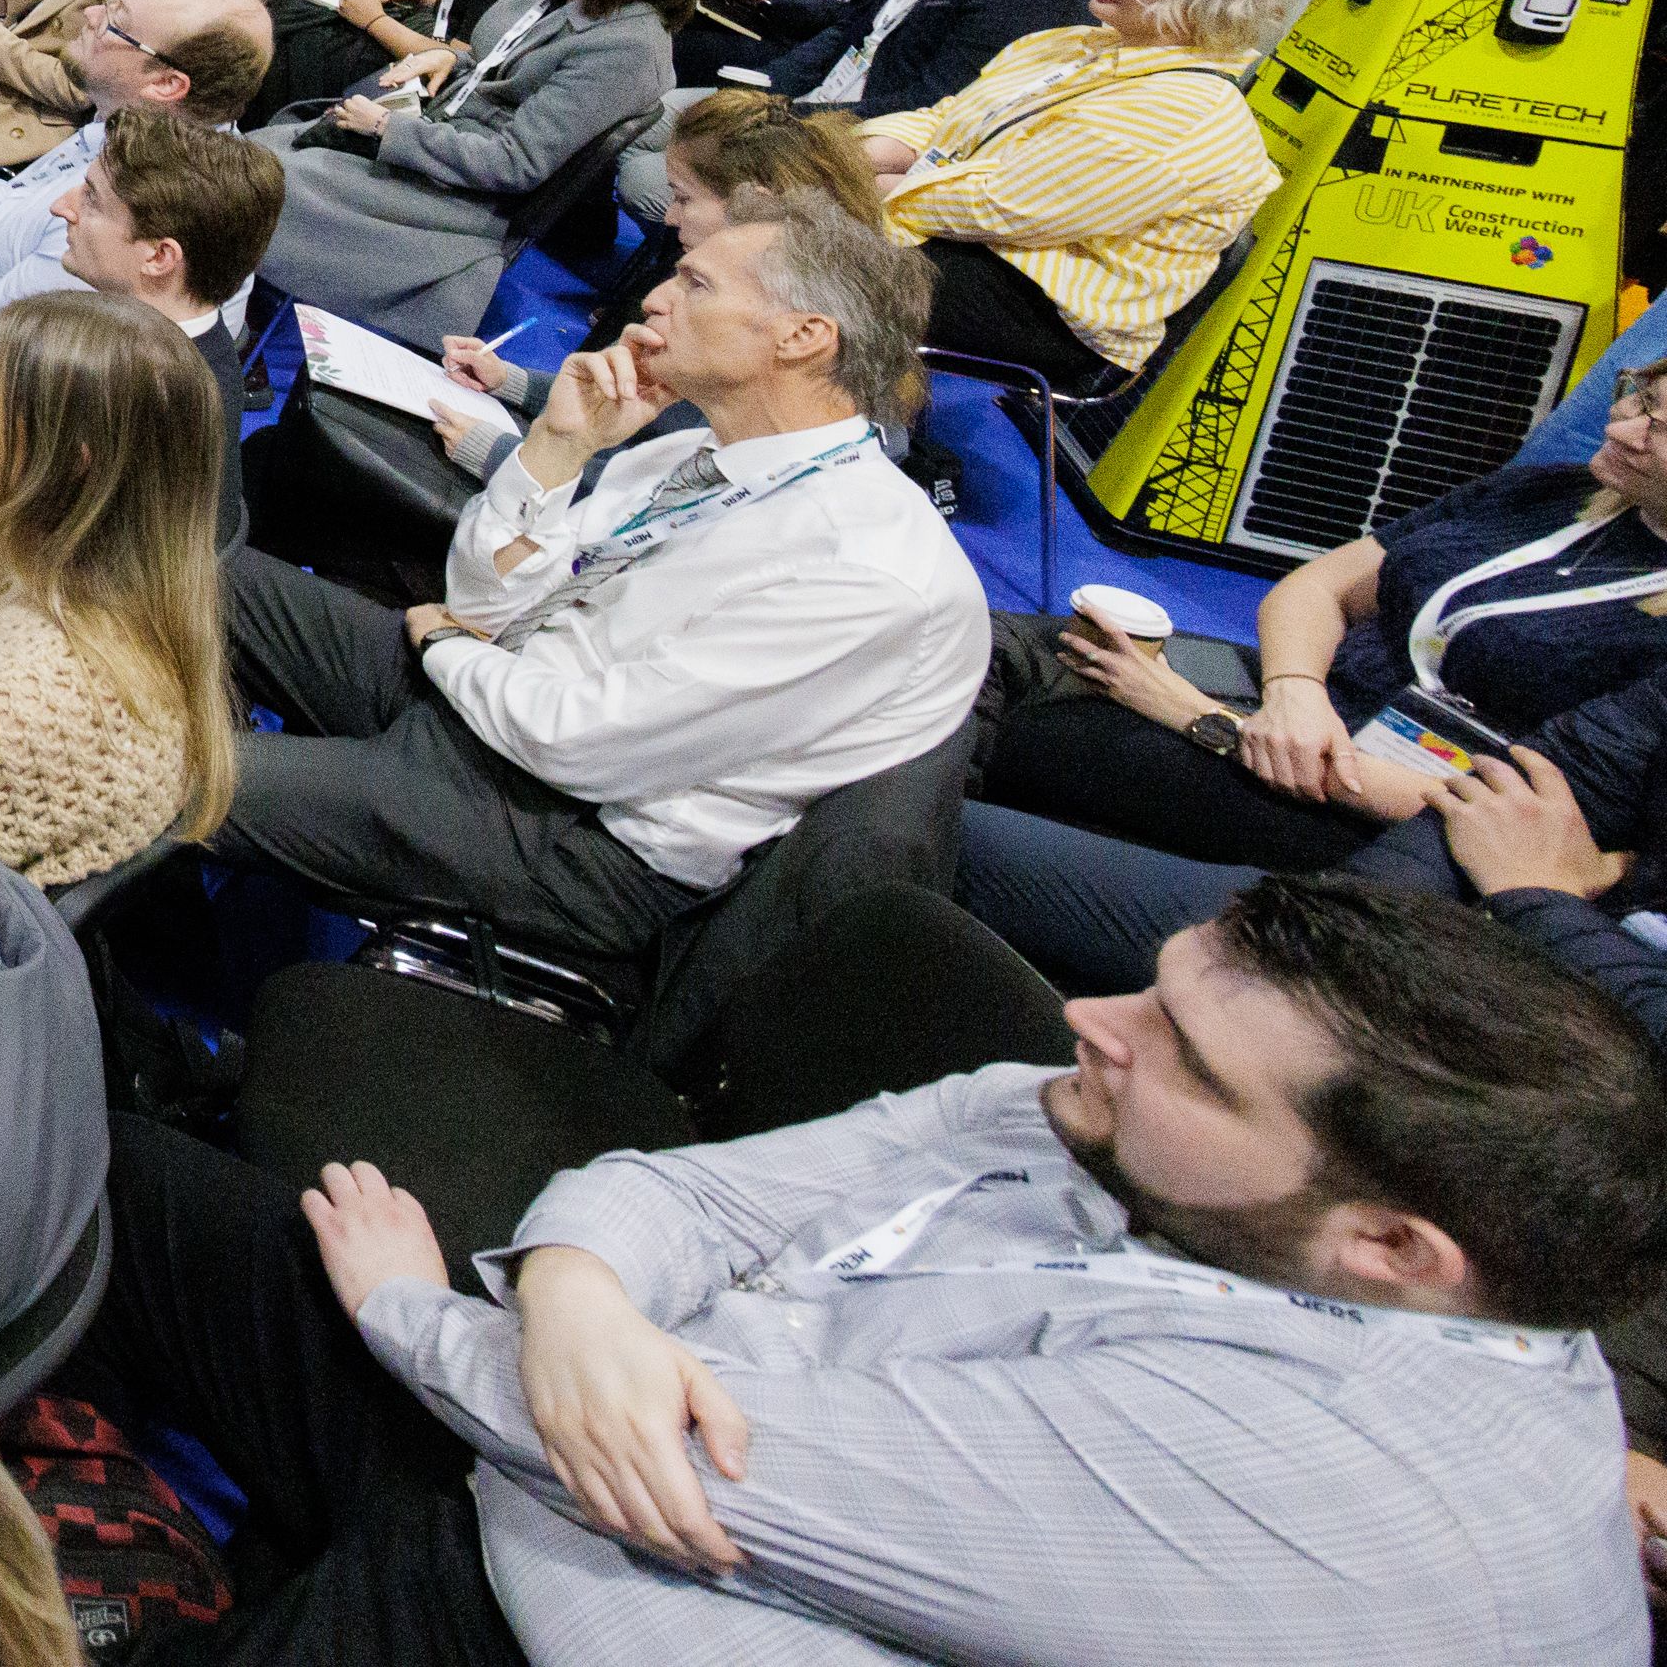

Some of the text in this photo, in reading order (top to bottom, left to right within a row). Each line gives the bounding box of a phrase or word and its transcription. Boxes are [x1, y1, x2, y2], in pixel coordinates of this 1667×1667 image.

[1286, 29, 1361, 82] PURETECH
[1404, 82, 1607, 125] PURETECH
[1384, 167, 1575, 206] IN PARTNERSHIP WITH
[1354, 183, 1584, 238] UK Construction
[1444, 217, 1503, 240] Week
[721, 486, 752, 508] MERS
[624, 530, 654, 548] MERS
